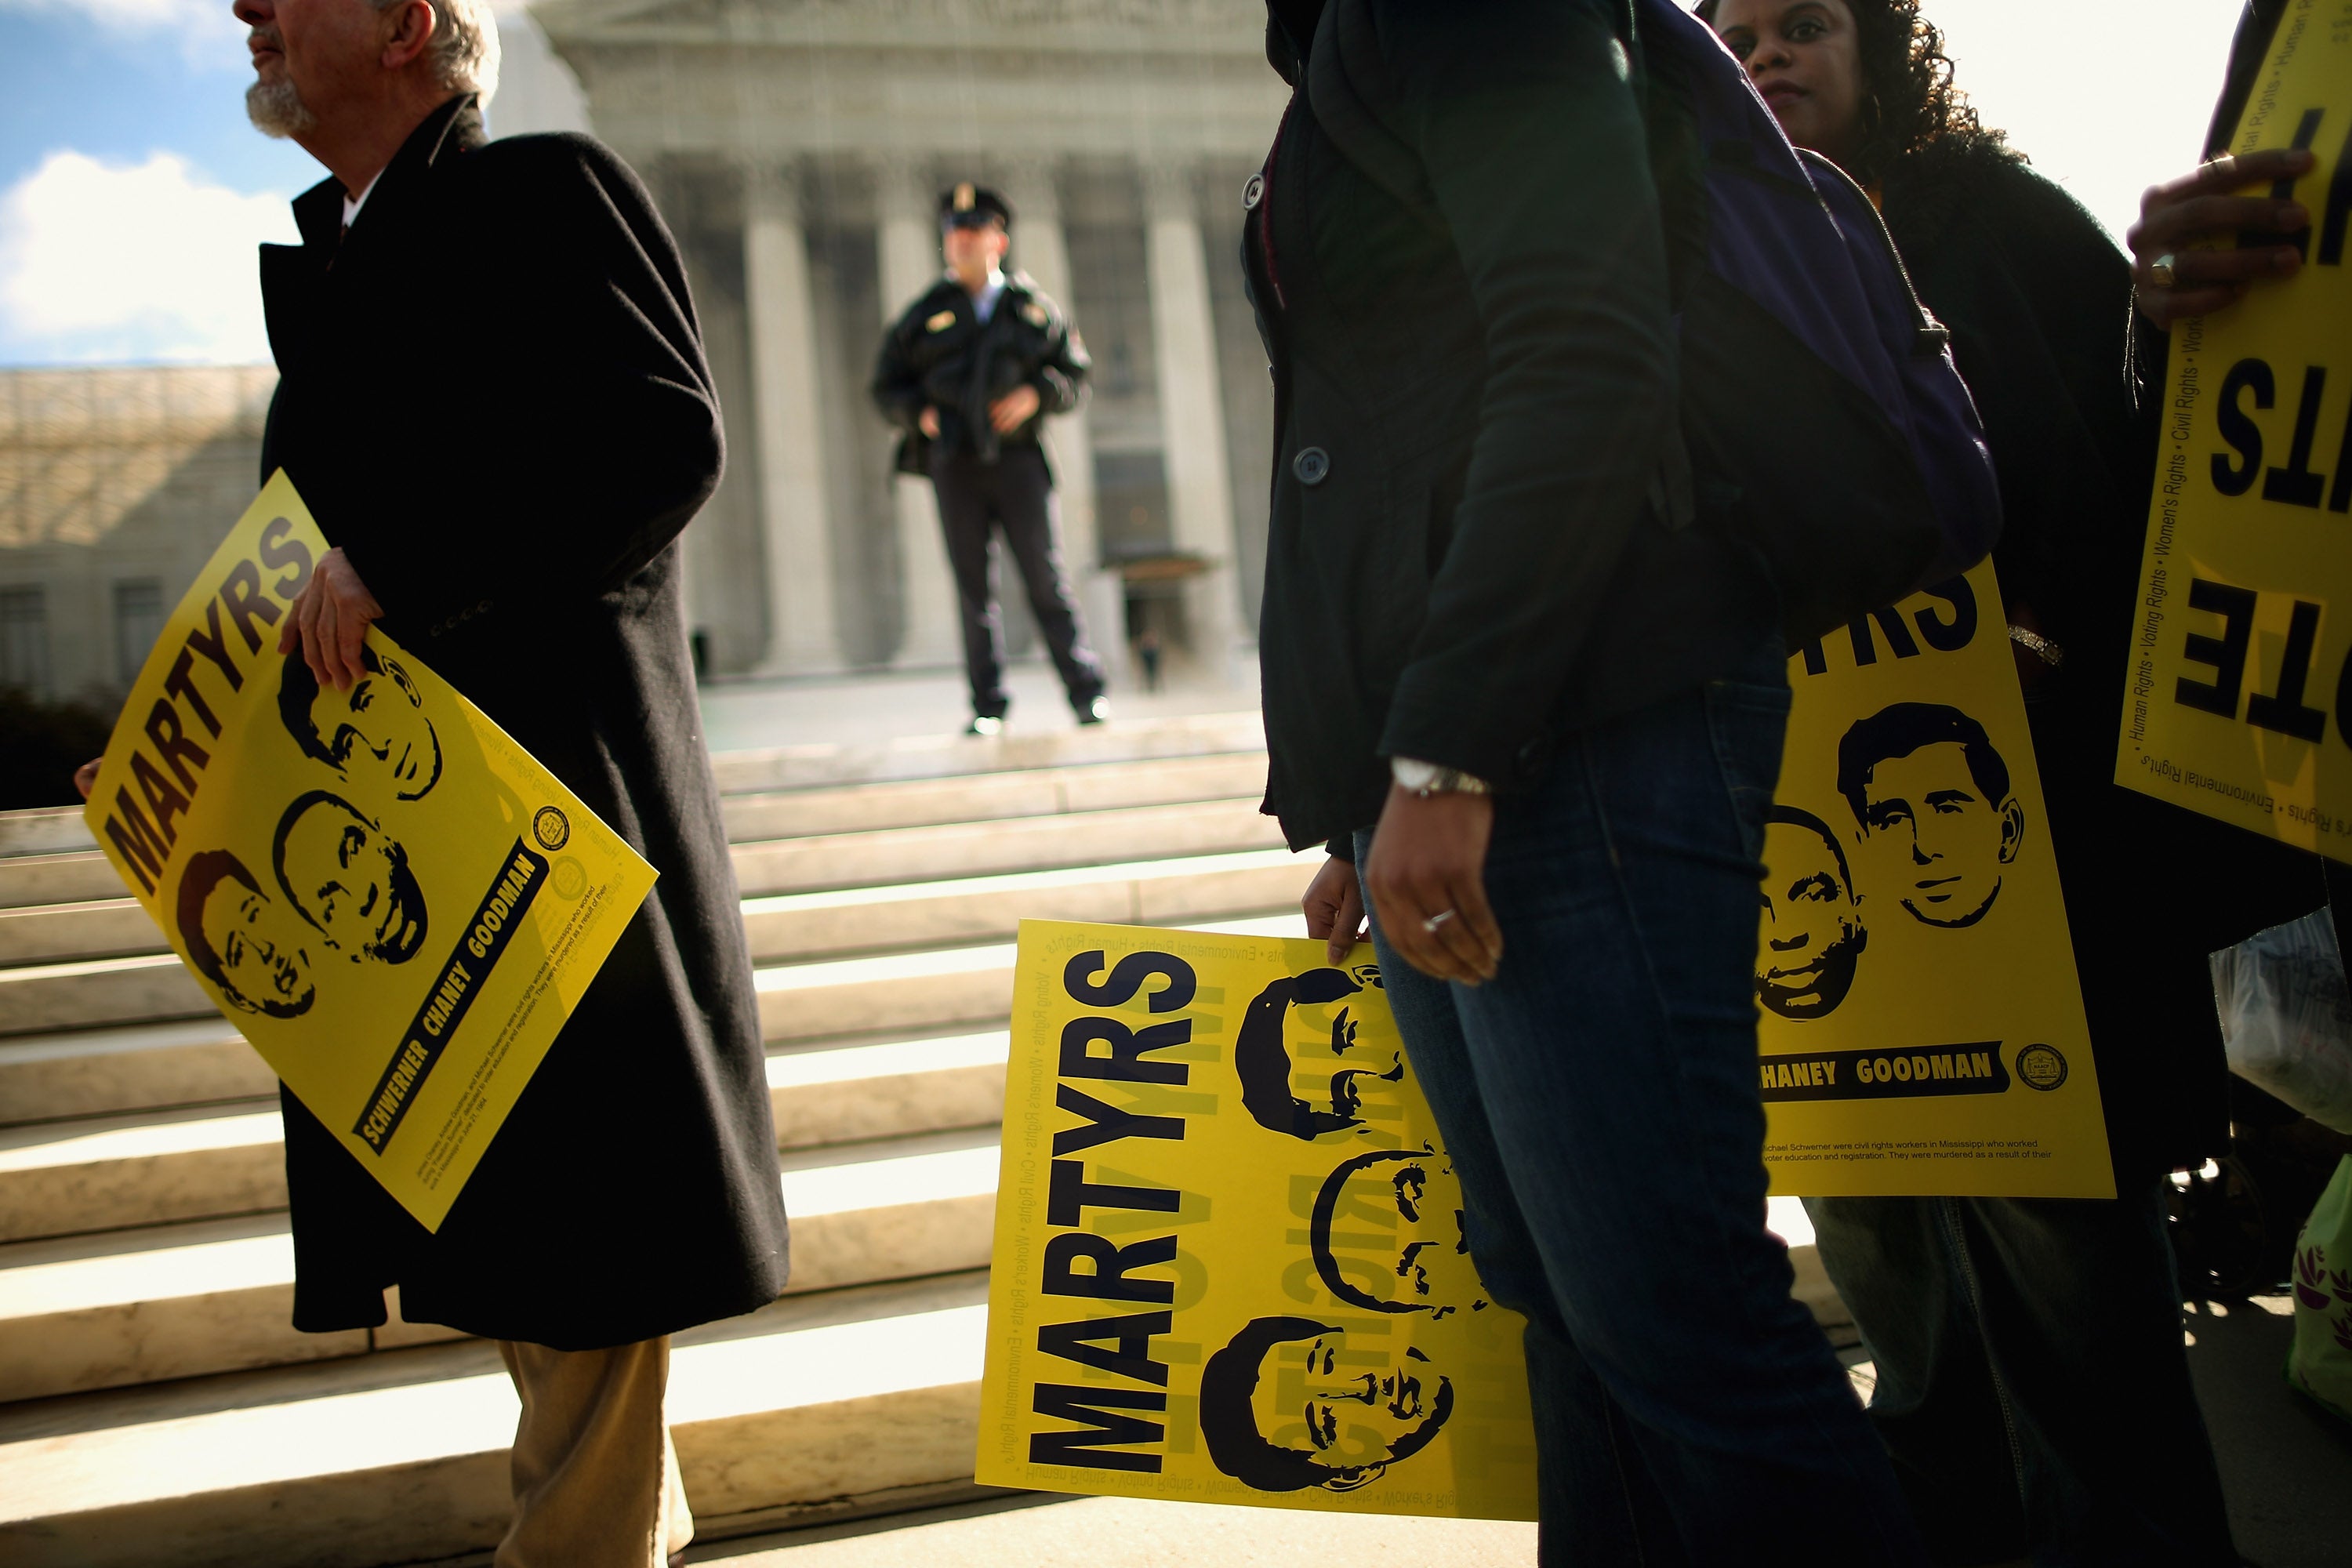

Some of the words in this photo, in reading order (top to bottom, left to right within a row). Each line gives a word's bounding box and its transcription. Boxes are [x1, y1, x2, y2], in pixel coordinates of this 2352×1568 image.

[2249, 82, 2281, 127] Rights
[2274, 14, 2305, 66] Human
[2181, 315, 2205, 353] Work
[2175, 366, 2201, 409] Rights
[2172, 412, 2190, 441] Civil
[2163, 452, 2188, 495] Rights
[2153, 495, 2178, 556] Women's
[2151, 568, 2169, 610] Rights
[2147, 611, 2164, 648] Voting
[2133, 659, 2154, 697] Rights
[104, 517, 314, 896] MARTYRS
[2129, 698, 2148, 742] Human
[2142, 754, 2181, 782] Rights
[2184, 772, 2274, 814] Environmental
[2288, 804, 2330, 833] Rights
[474, 1057, 490, 1079] Michael
[506, 1013, 517, 1027] were
[514, 1000, 524, 1013] civil
[521, 984, 535, 1001] rights
[532, 960, 549, 984] workers
[549, 921, 574, 954] Mississippi
[569, 908, 581, 922] who
[577, 884, 595, 909] worked
[491, 1041, 510, 1068] education
[507, 1029, 518, 1042] and
[535, 980, 550, 996] They
[545, 966, 557, 981] were
[554, 937, 575, 966] murdered
[580, 906, 593, 924] result
[595, 884, 607, 899] their
[364, 1040, 430, 1146] SCHWERNER
[422, 962, 474, 1037] CHANEY
[467, 852, 535, 960] GOODMAN
[1759, 1061, 1837, 1089] HANEY
[1855, 1051, 1993, 1084] GOODMAN
[1841, 1152, 1886, 1161] registration.
[1889, 1152, 1909, 1160] They
[1871, 1142, 1893, 1150] rights
[1029, 949, 1198, 1473] MARTYRS
